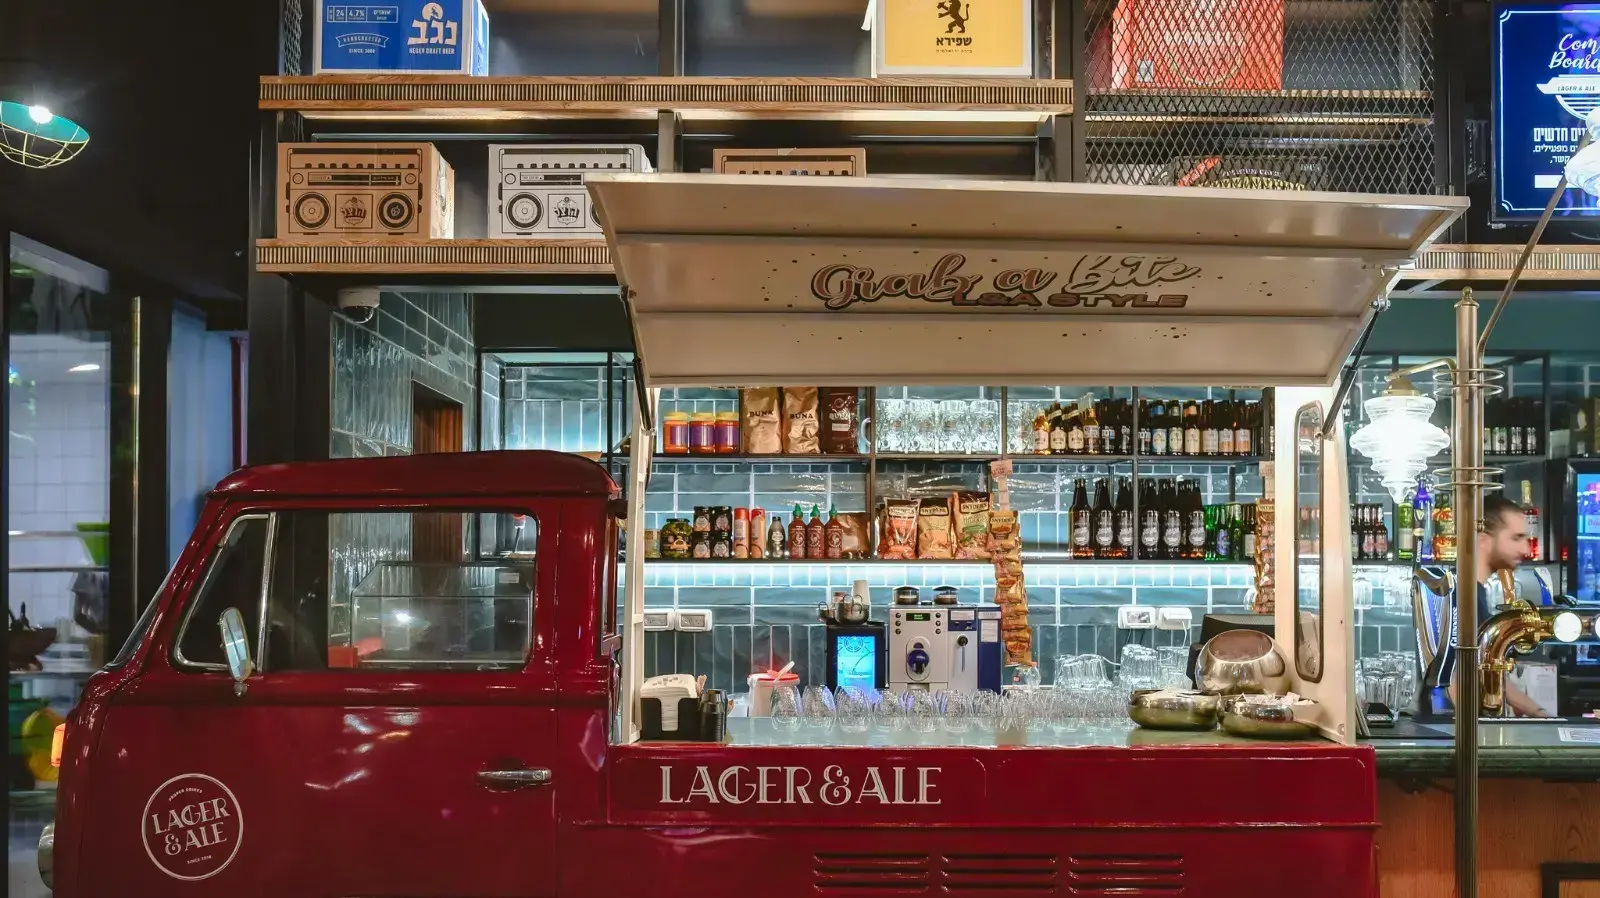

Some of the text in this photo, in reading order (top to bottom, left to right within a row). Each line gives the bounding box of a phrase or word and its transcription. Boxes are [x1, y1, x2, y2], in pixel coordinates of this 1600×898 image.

[348, 9, 365, 17] 4.7%
[342, 35, 382, 43] HANDCRAFTED
[407, 19, 458, 46] נגב
[936, 36, 973, 47] שפירא
[1533, 127, 1569, 142] חדשים
[811, 252, 983, 310] Grab
[993, 263, 1059, 293] a
[951, 291, 1189, 308] L&A STYLE
[659, 764, 942, 805] LAGER & ALE
[168, 788, 185, 802] PROPER
[151, 797, 230, 835] LAGER
[164, 821, 228, 856] & ALE
